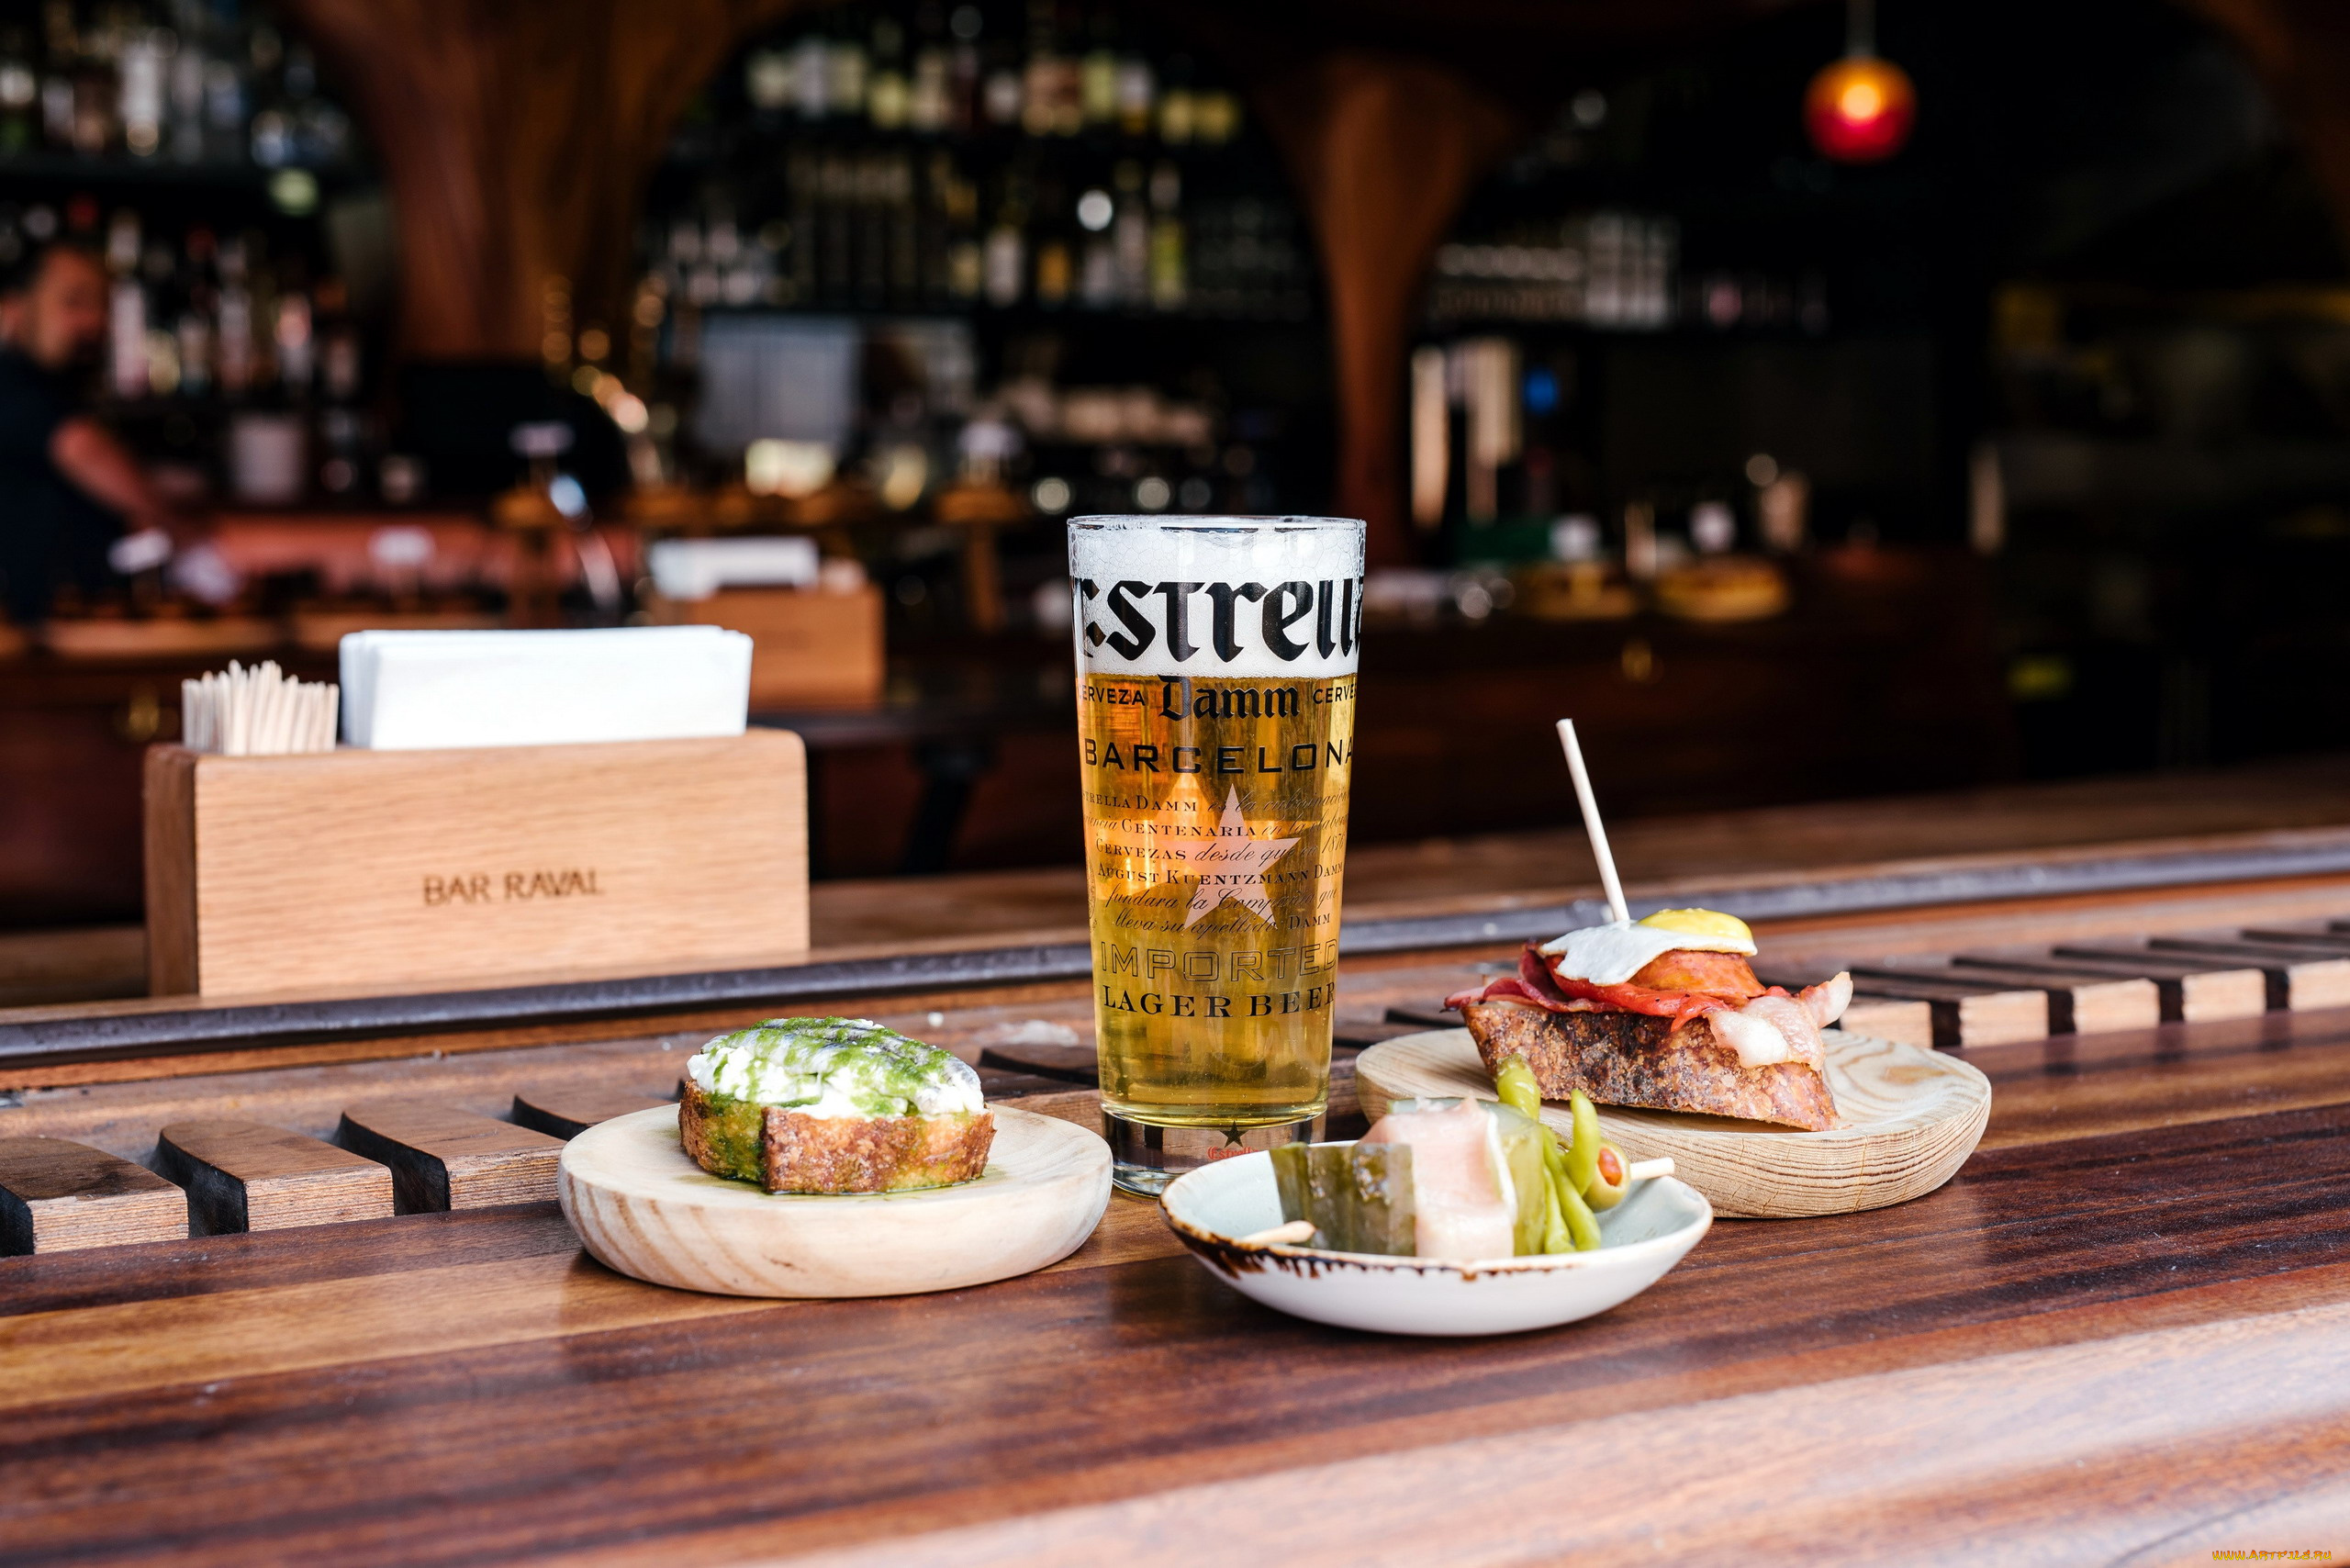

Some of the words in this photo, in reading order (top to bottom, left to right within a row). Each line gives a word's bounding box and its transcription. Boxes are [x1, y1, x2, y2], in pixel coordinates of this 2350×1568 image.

[1079, 684, 1146, 706] ERVEZA
[1158, 675, 1301, 722] Damm
[1194, 842, 1256, 862] desde
[423, 872, 491, 906] BAR
[503, 867, 604, 900] RAVAL
[1105, 882, 1180, 910] fundara
[1115, 907, 1157, 931] lleva
[1101, 939, 1337, 982] IMPORTED
[1102, 984, 1233, 1018] LAGER
[1246, 981, 1335, 1018] BEER
